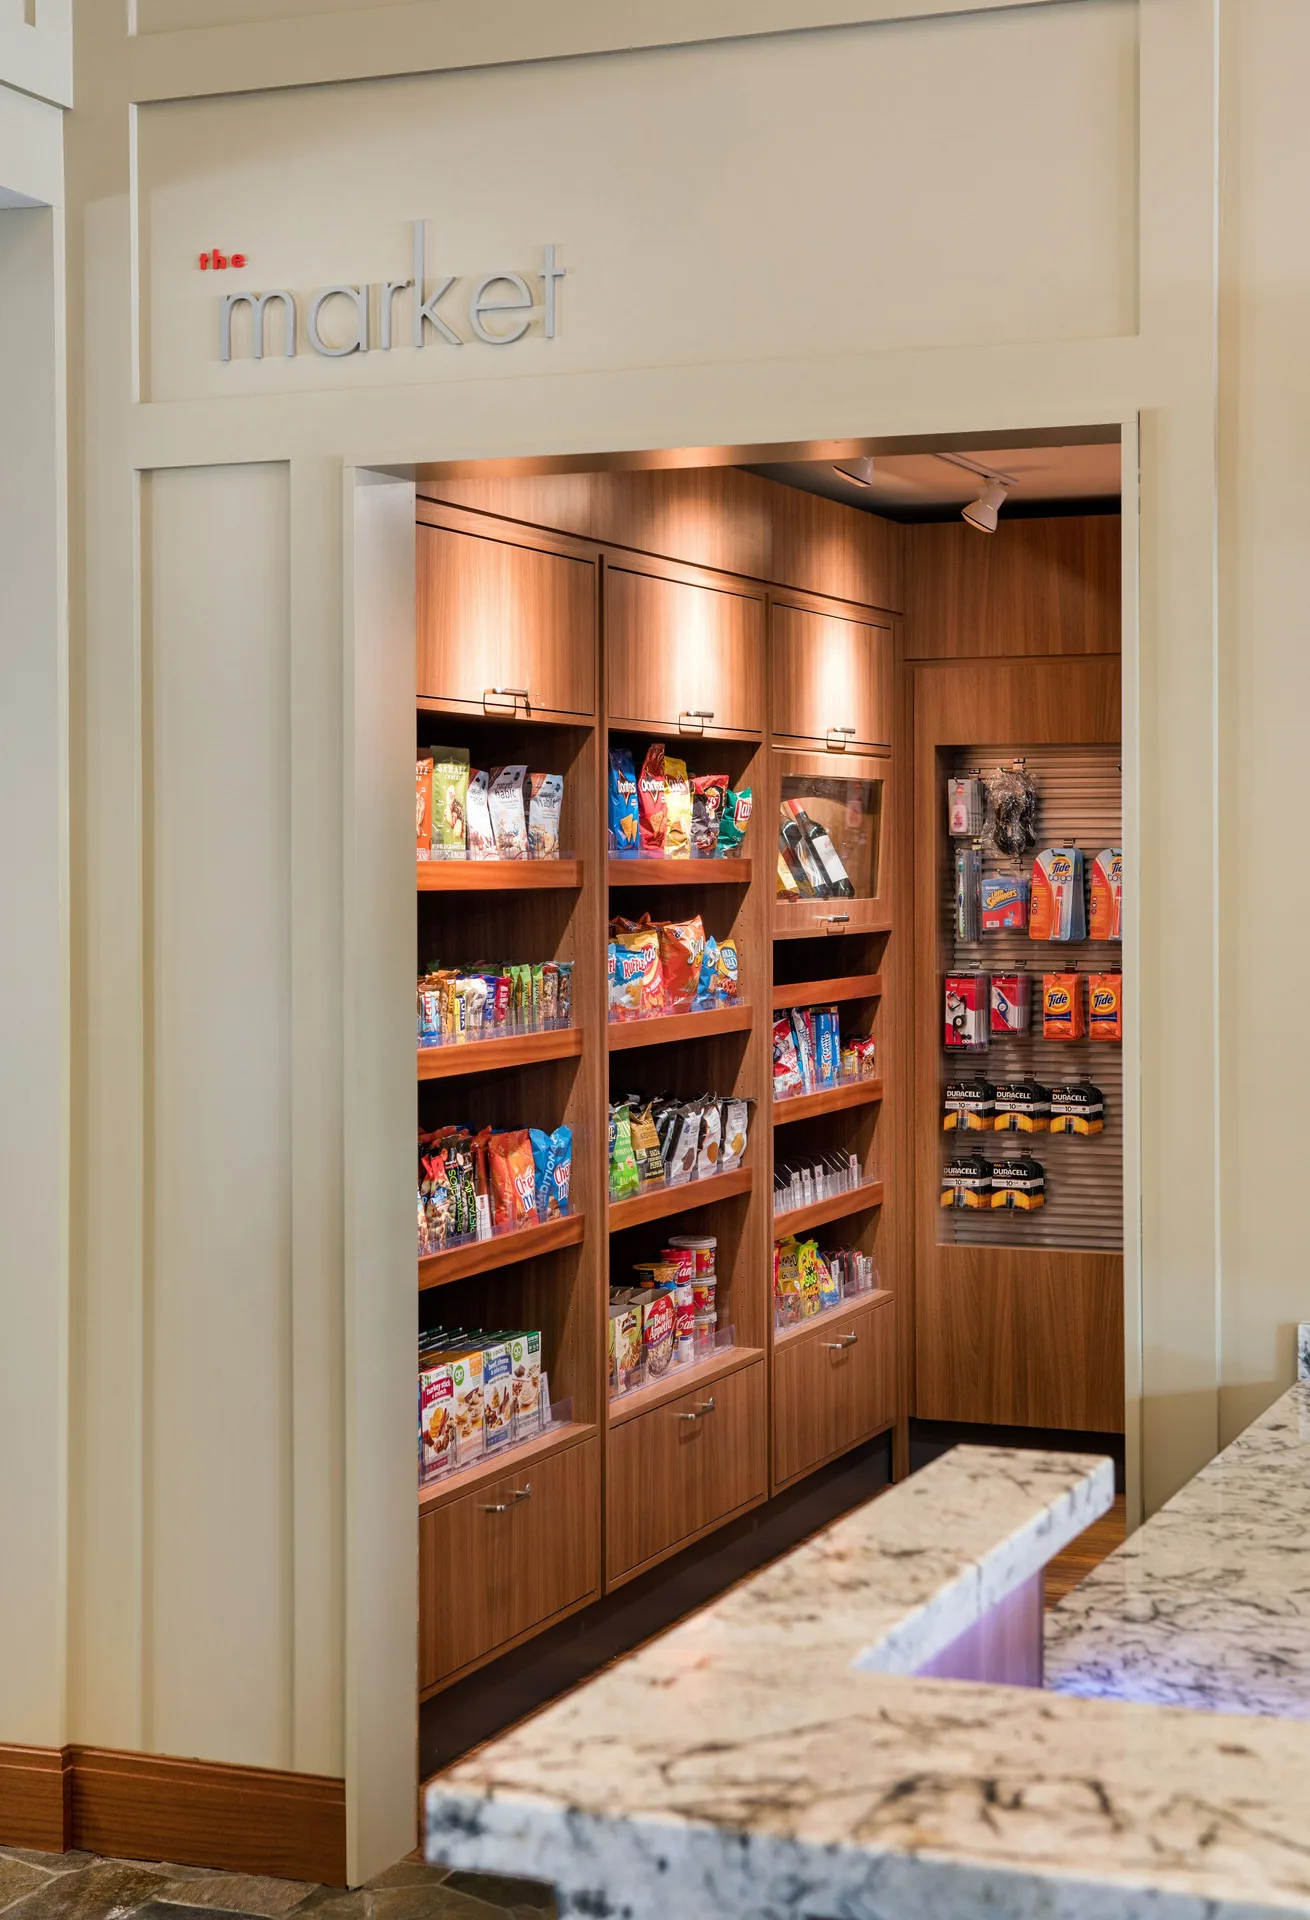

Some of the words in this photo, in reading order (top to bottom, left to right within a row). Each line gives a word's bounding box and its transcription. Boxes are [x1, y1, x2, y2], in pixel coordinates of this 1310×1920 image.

[199, 248, 247, 270] the
[220, 219, 566, 361] market
[1052, 862, 1070, 875] Tide
[1048, 994, 1068, 1008] Tide
[1094, 994, 1113, 1008] Tide
[946, 1090, 980, 1098] DURACELL
[996, 1091, 1031, 1099] DURACELL
[1052, 1093, 1087, 1102] DURACELL
[944, 1167, 977, 1175] DURACELL
[993, 1168, 1028, 1176] DURACELL
[464, 1179, 477, 1232] PISTACHIO
